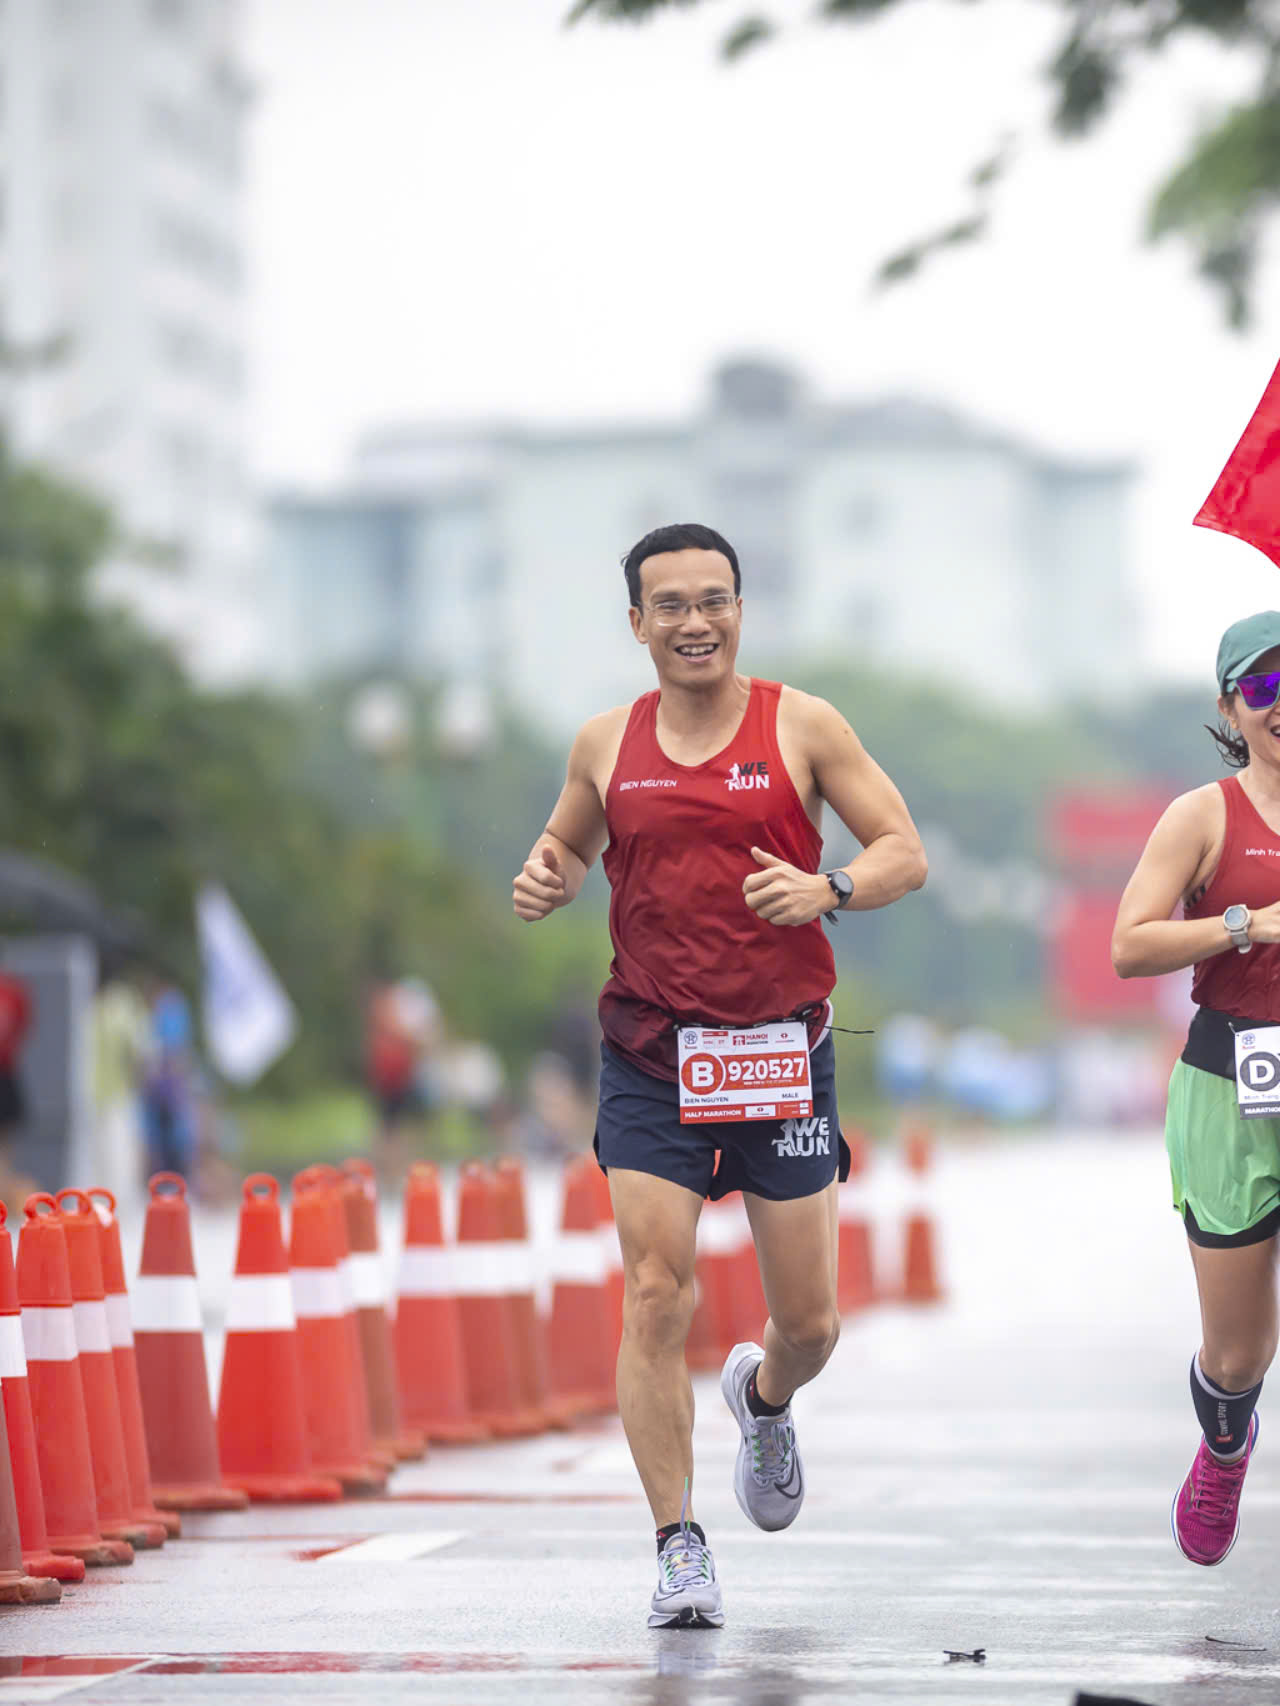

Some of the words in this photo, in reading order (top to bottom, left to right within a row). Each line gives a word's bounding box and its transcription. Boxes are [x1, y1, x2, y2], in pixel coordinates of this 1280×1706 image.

[738, 762, 768, 775] WE
[640, 779, 678, 788] NGUYEN
[727, 775, 770, 791] RUN
[1245, 848, 1266, 856] Minh
[691, 1061, 715, 1088] B
[728, 1057, 805, 1082] 920527
[1248, 1059, 1275, 1084] D
[793, 1117, 830, 1137] WE
[777, 1135, 831, 1157] RUN
